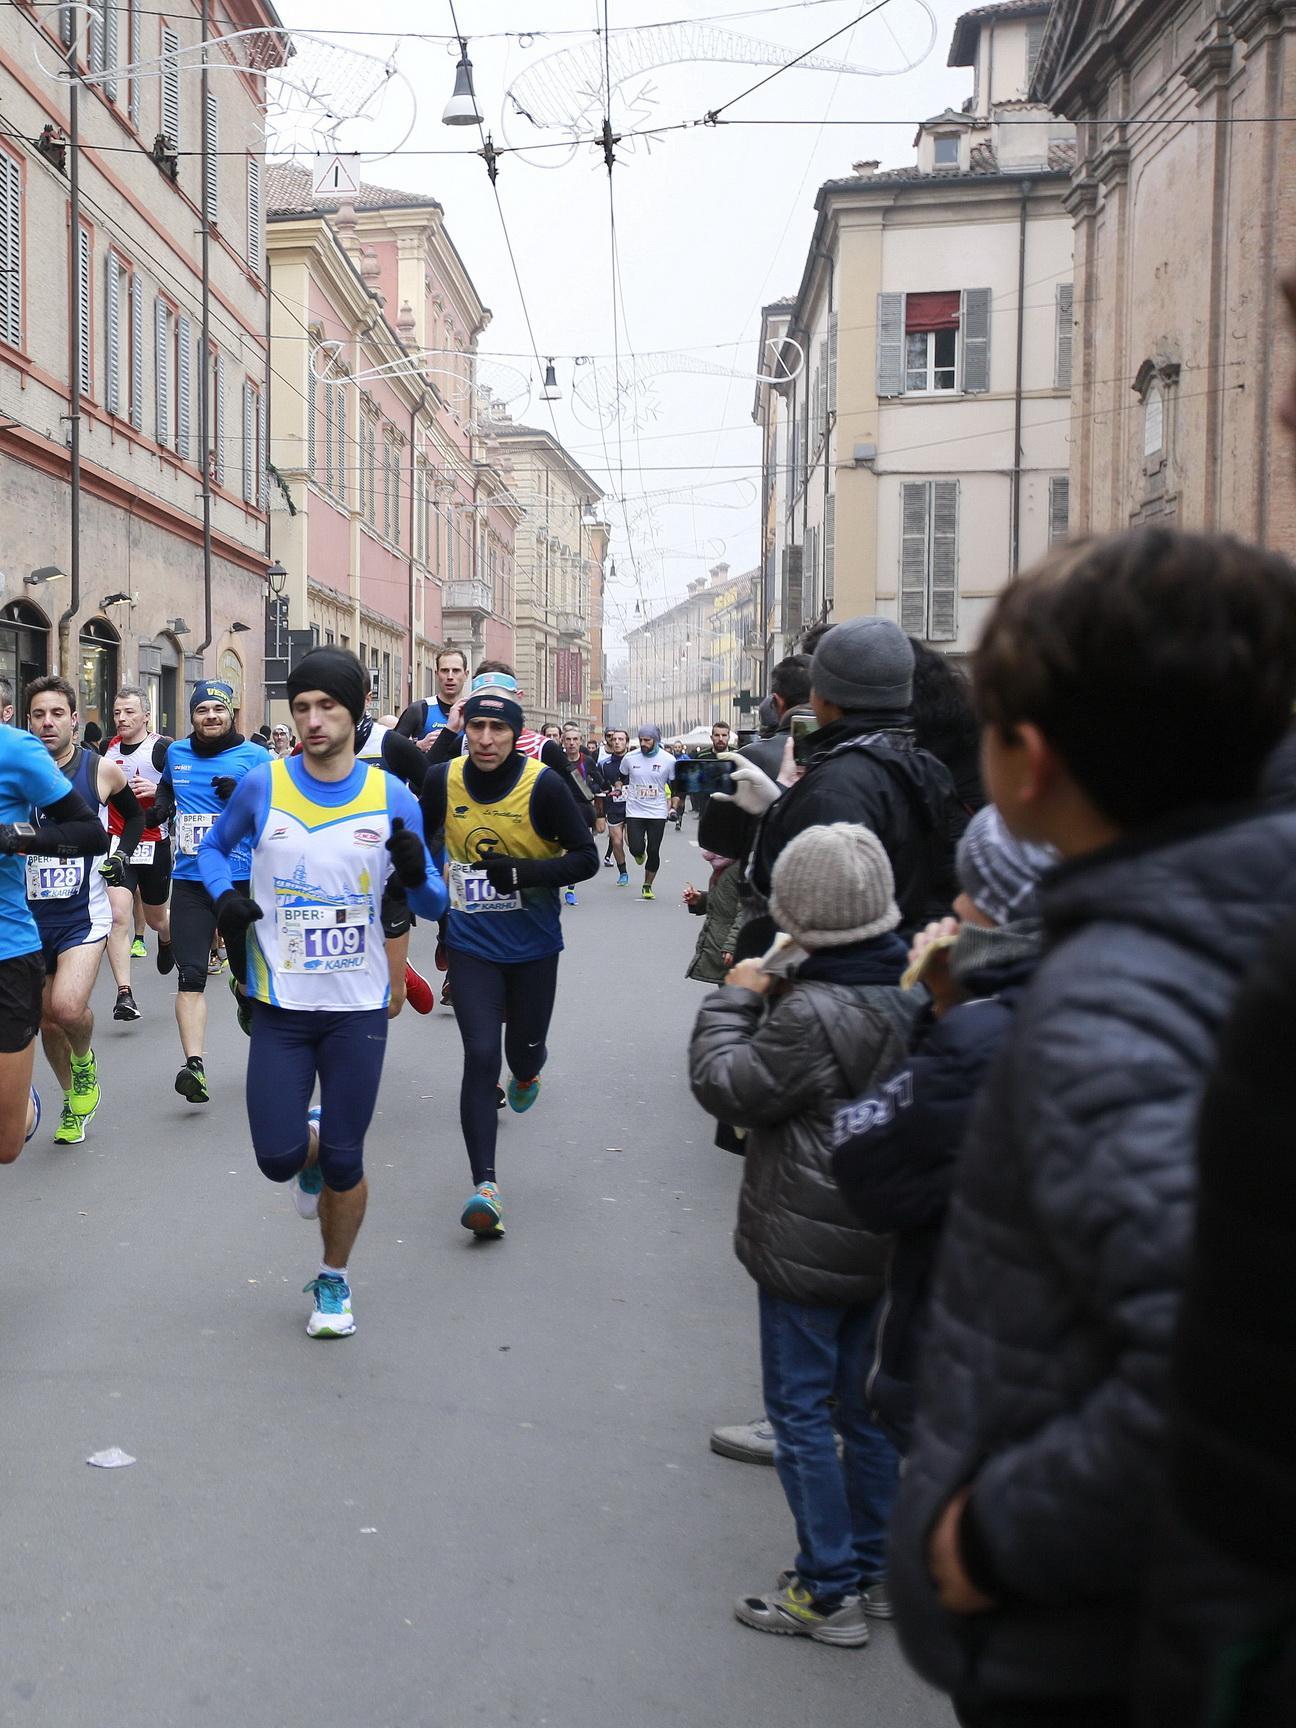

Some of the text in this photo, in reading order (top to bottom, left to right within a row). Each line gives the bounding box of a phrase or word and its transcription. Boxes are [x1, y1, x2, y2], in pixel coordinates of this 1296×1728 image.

[42, 869, 77, 888] 128
[469, 879, 512, 901] 10
[284, 909, 325, 921] BPER:
[310, 927, 361, 956] 109
[324, 957, 365, 971] KARHU
